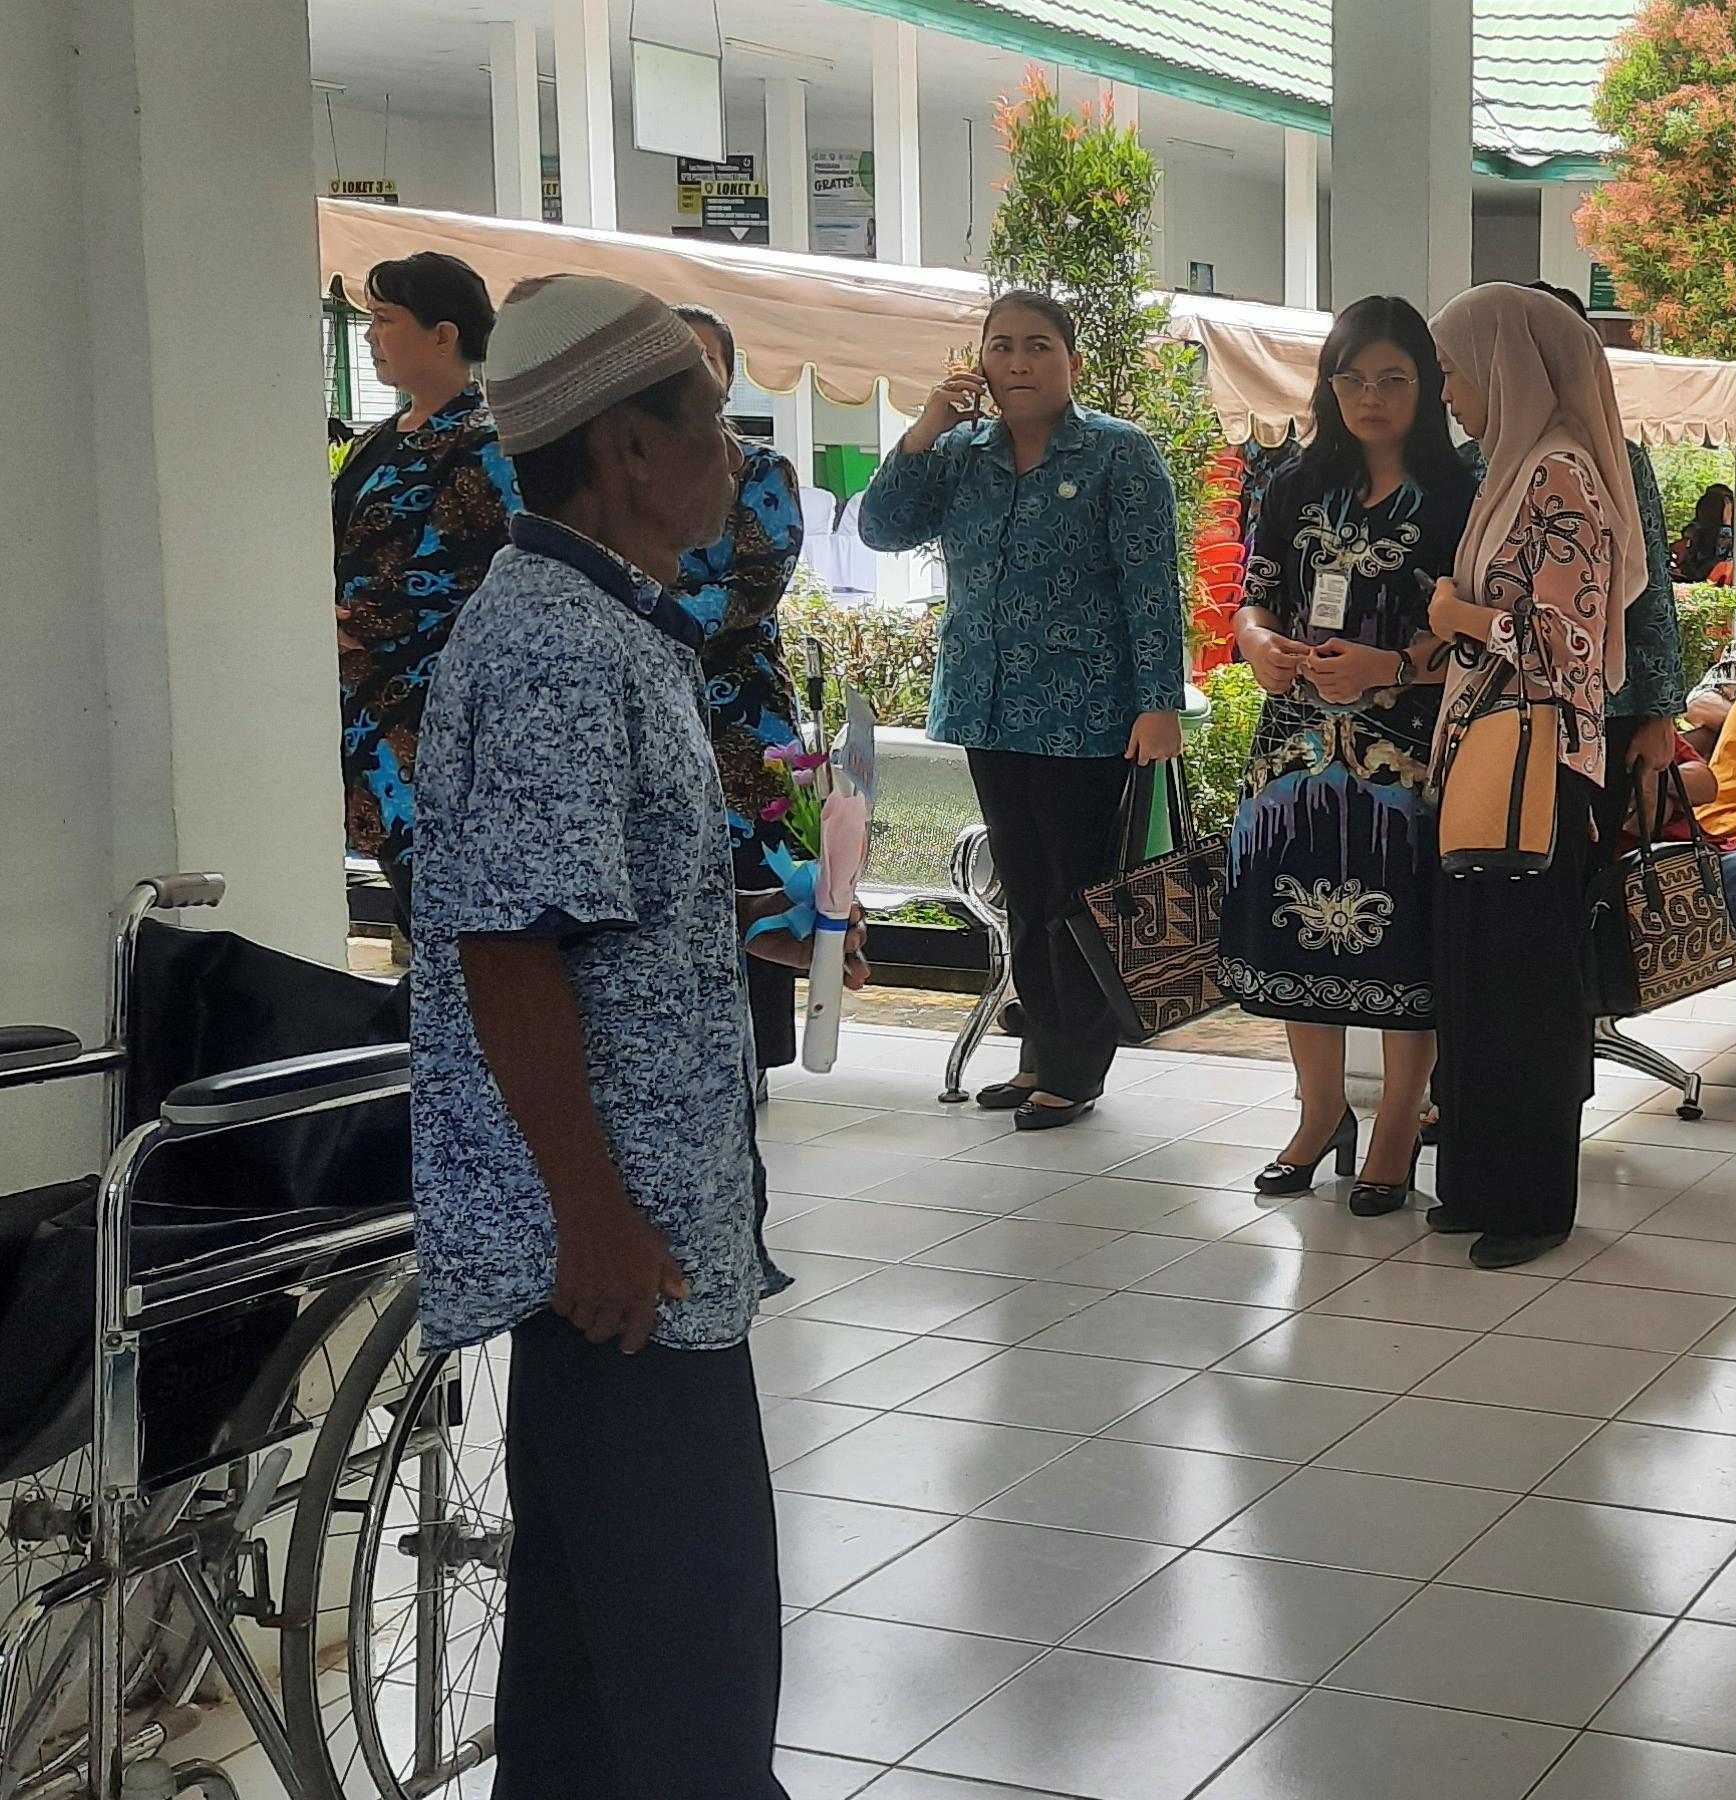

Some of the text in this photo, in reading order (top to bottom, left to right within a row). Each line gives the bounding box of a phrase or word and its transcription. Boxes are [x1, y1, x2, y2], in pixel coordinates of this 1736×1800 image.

[342, 180, 374, 194] LOKET
[716, 182, 760, 196] LOKET 1
[814, 177, 854, 192] GRATIS
